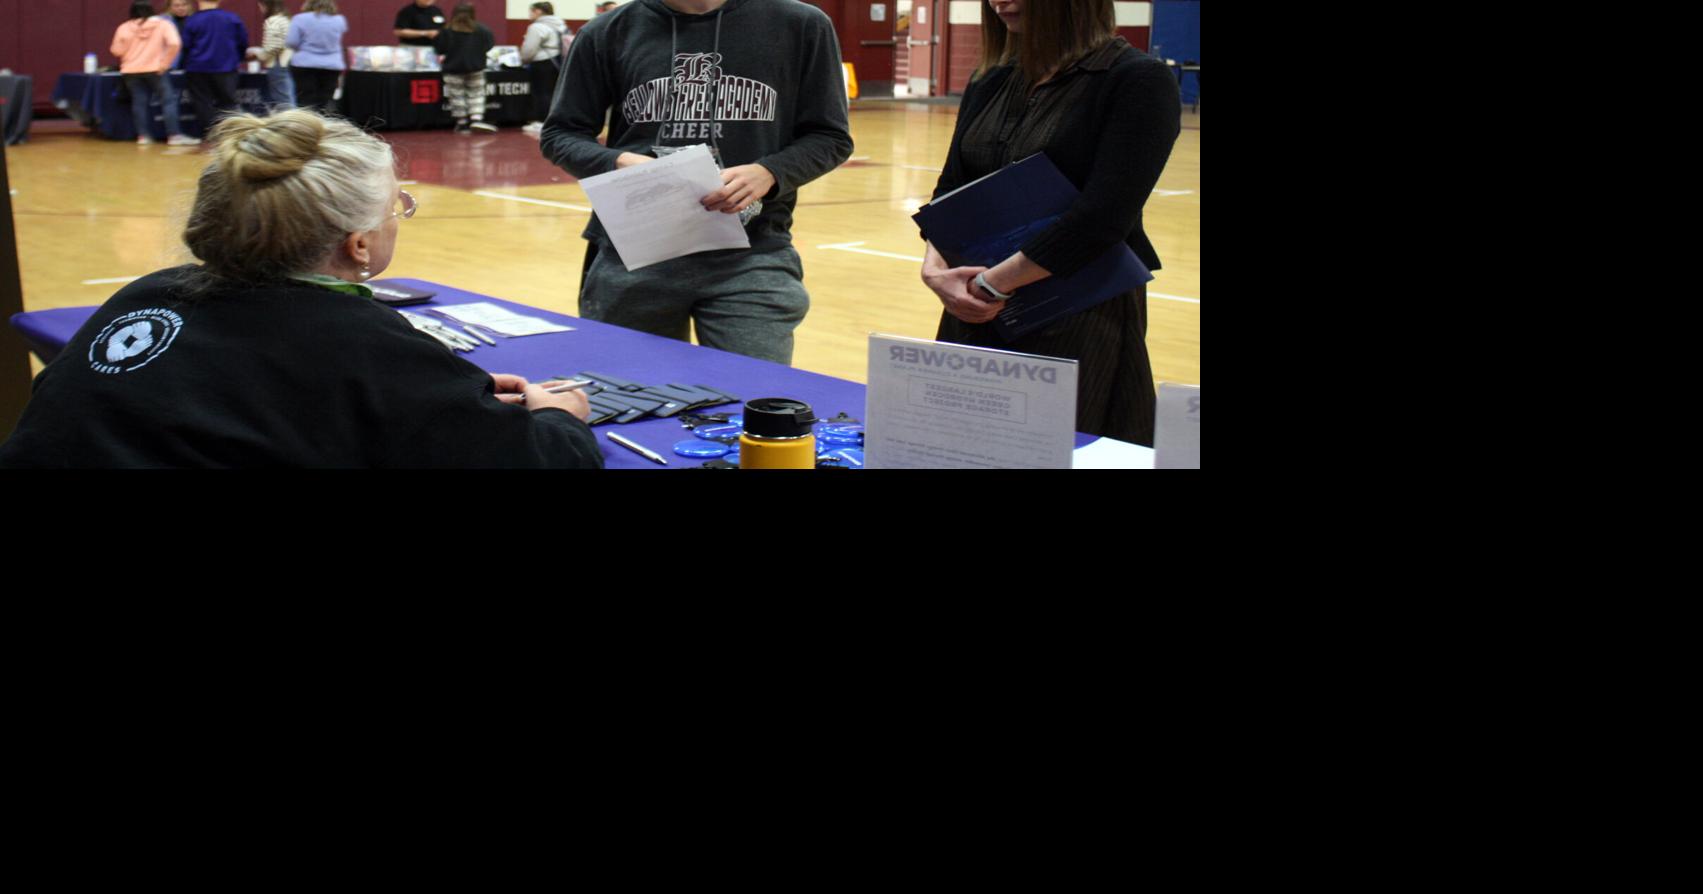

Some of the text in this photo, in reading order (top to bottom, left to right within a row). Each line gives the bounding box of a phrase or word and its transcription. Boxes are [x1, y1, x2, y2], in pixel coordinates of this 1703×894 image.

[499, 82, 530, 95] TECH
[674, 82, 711, 122] FREE
[714, 74, 777, 122] ACADEMY
[661, 122, 724, 139] CHEER
[127, 308, 183, 328] DYNAPOWER
[90, 361, 121, 374] CARES
